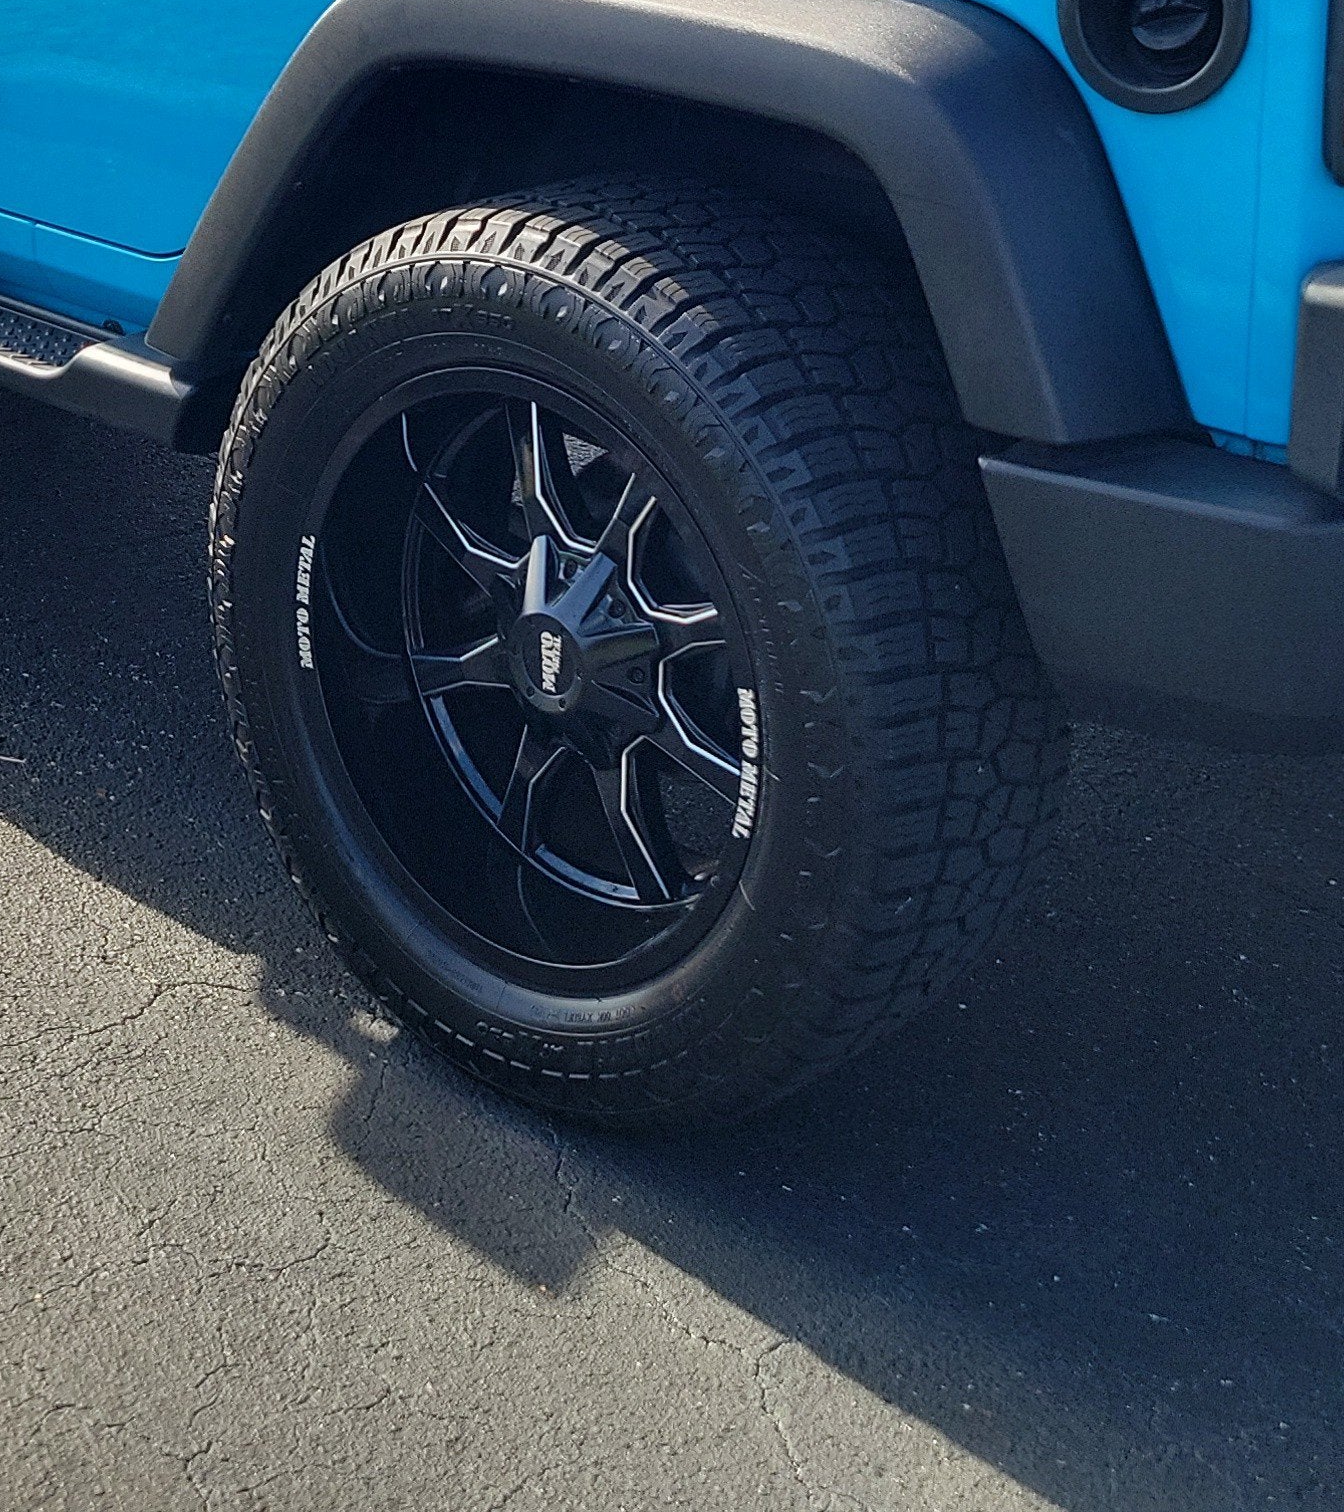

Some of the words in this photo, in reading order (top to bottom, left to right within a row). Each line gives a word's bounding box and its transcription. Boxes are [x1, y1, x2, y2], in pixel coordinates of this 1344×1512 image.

[296, 534, 316, 605] METAL
[296, 607, 315, 670] MOTO
[540, 631, 557, 694] MOTO
[736, 687, 759, 759] MOTO
[731, 759, 759, 839] METAL
